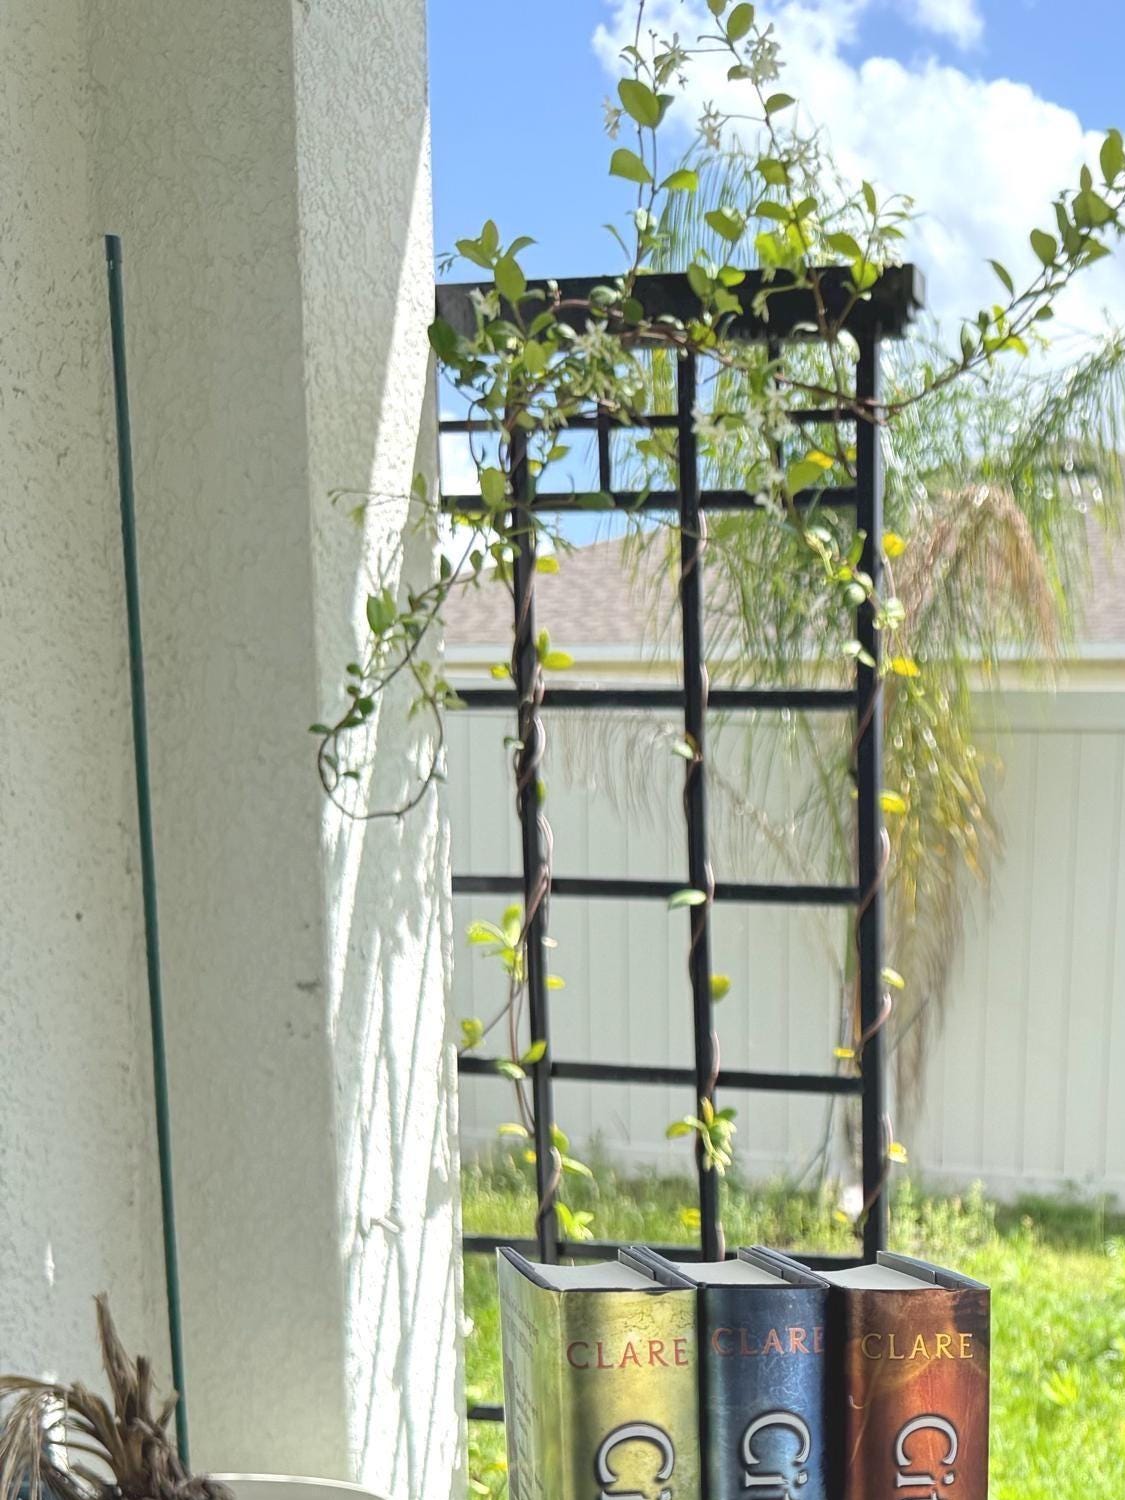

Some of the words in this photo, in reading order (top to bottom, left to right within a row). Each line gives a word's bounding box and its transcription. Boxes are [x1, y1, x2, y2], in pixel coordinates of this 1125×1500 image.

[566, 1337, 690, 1370] CLARE
[710, 1326, 824, 1357] CLARE
[860, 1332, 974, 1361] CLARE
